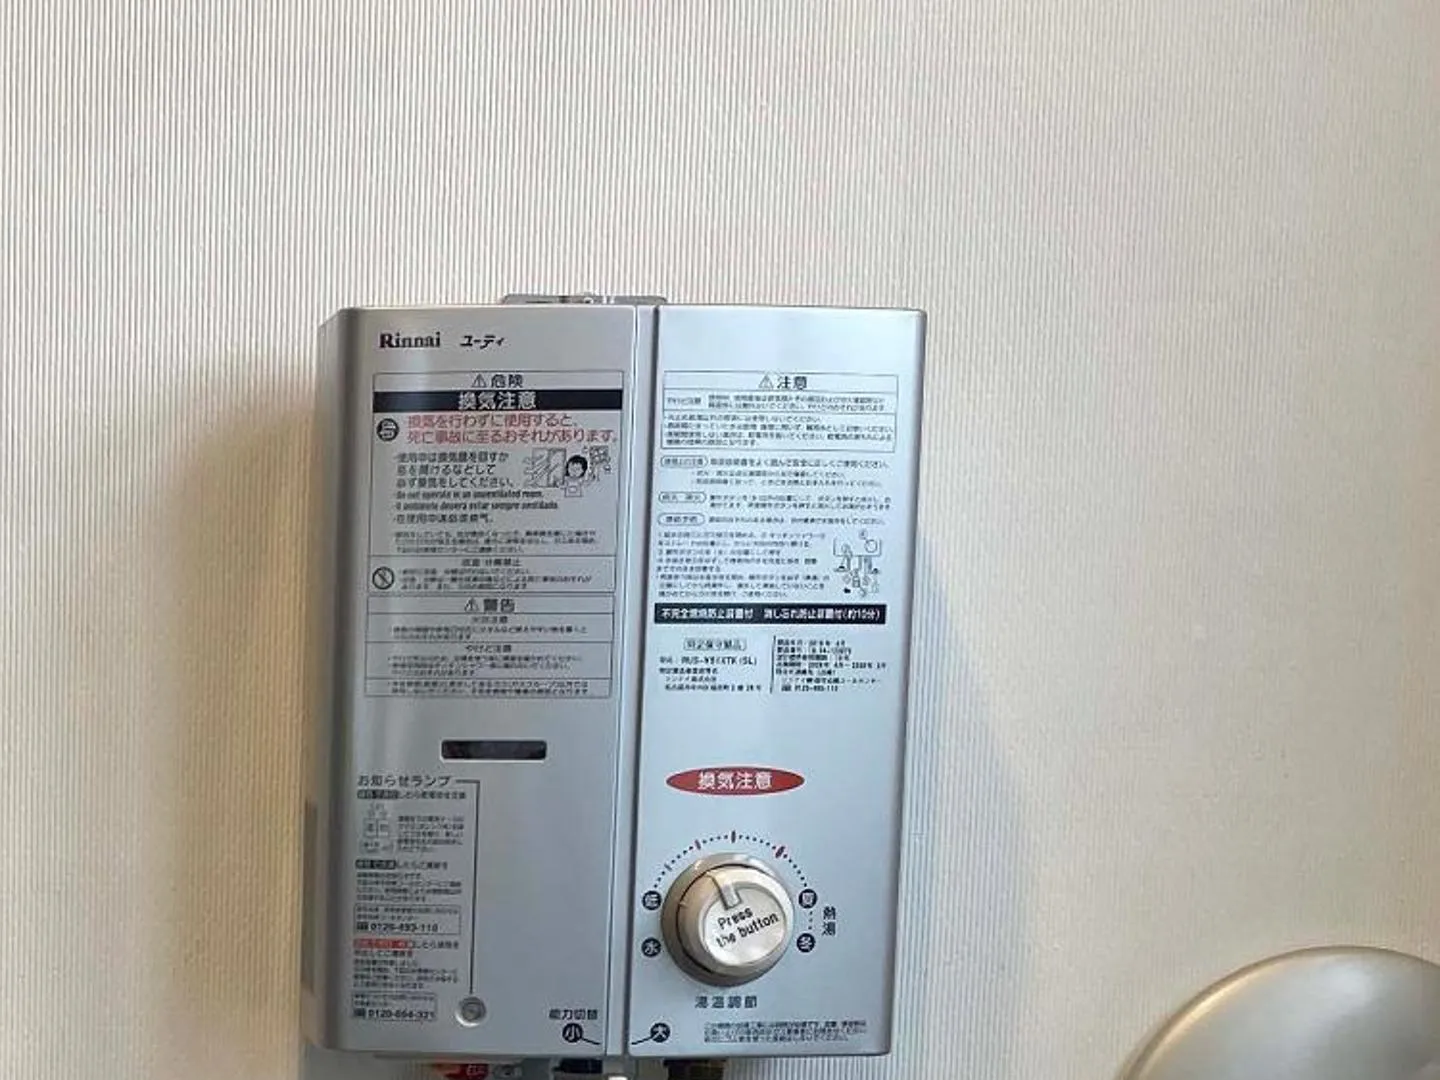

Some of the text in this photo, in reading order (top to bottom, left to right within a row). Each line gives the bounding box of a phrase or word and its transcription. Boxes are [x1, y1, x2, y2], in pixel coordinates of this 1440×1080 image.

[379, 332, 441, 348] Rinnai
[490, 374, 524, 388] 危険
[777, 376, 808, 390] 注意
[459, 391, 537, 410] 換気注意
[697, 772, 772, 790] 換気注意
[718, 908, 754, 929] Press
[716, 912, 780, 948] the button
